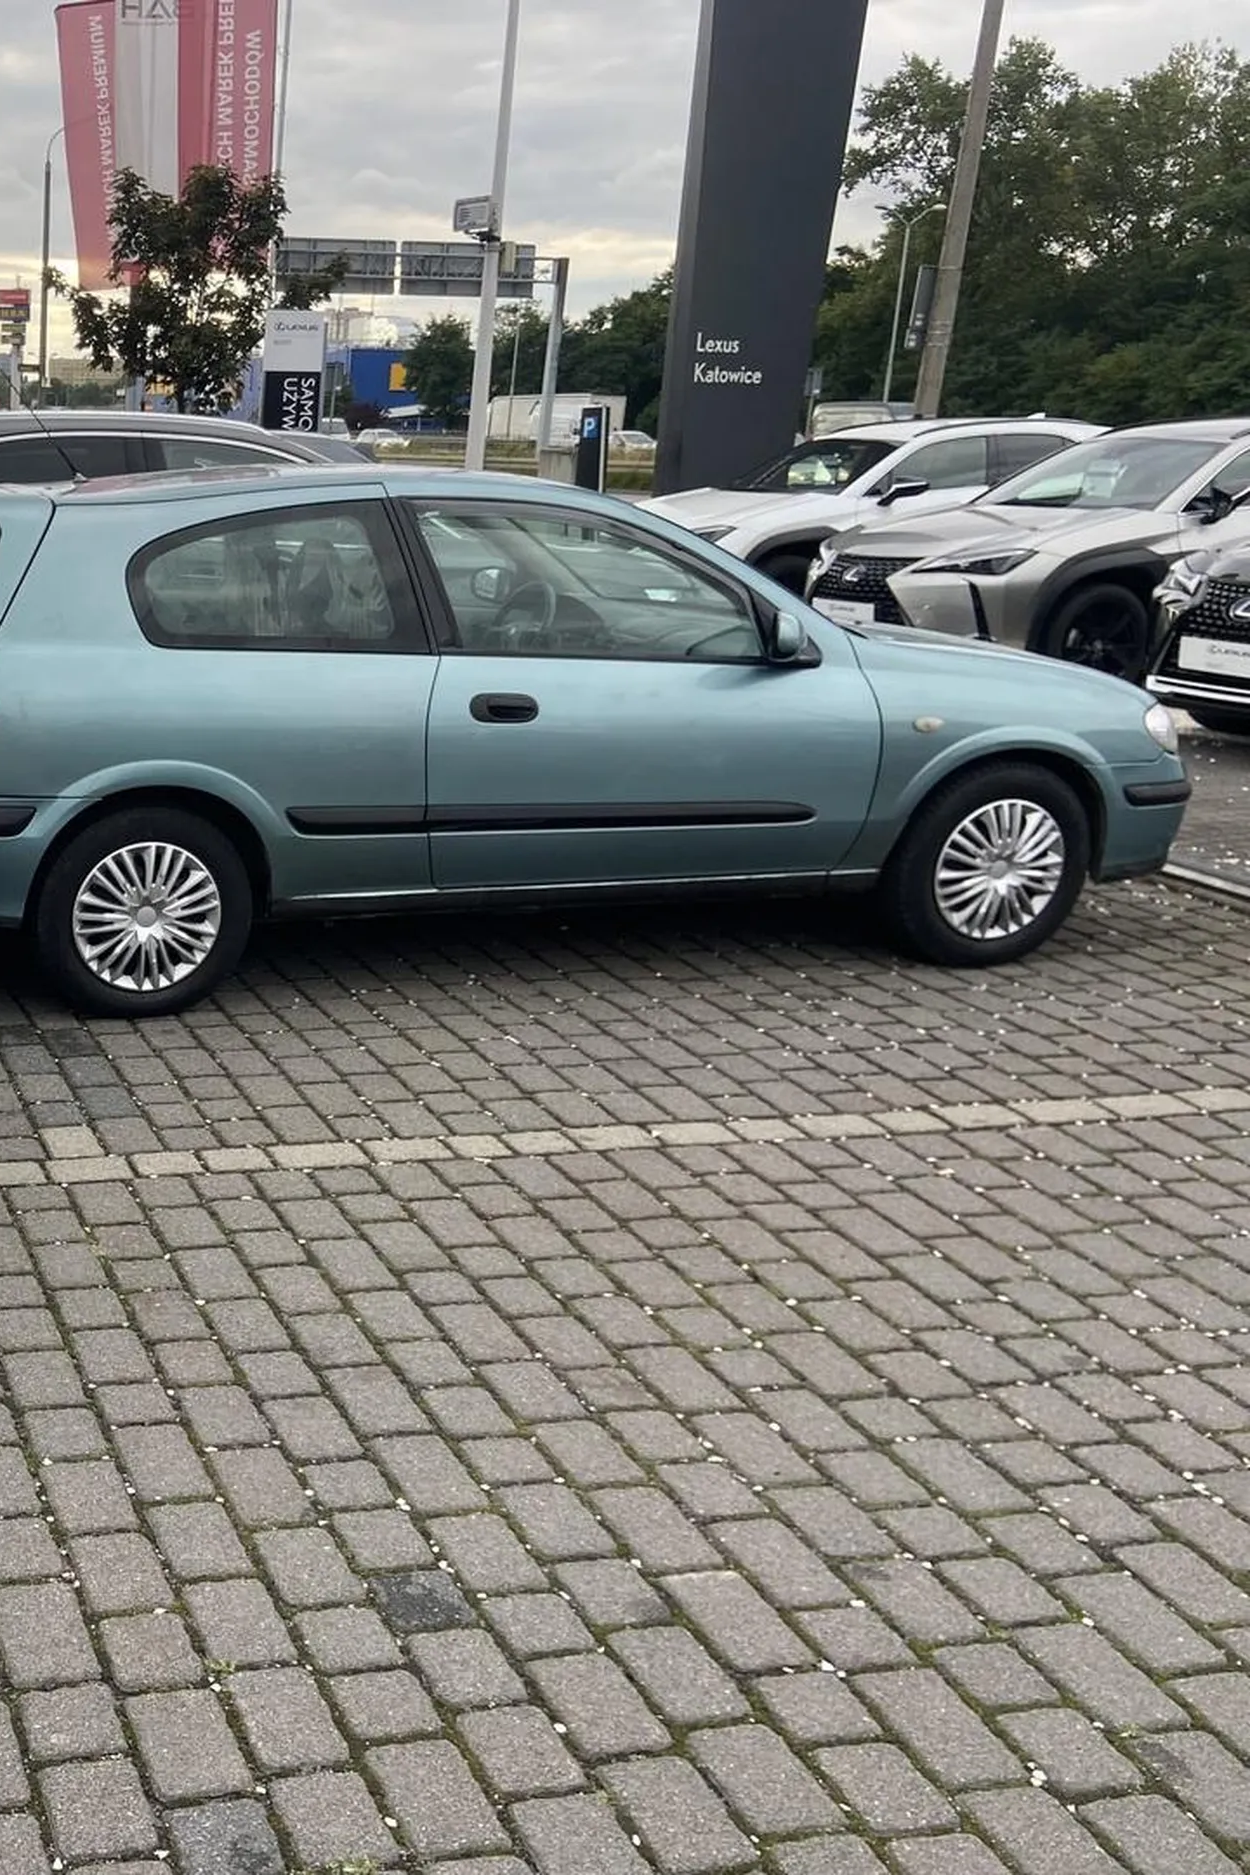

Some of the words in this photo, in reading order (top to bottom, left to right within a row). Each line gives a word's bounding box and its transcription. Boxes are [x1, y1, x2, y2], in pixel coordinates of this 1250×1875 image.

[696, 331, 740, 353] Lexus
[693, 362, 762, 384] Katowice
[583, 417, 595, 438] P
